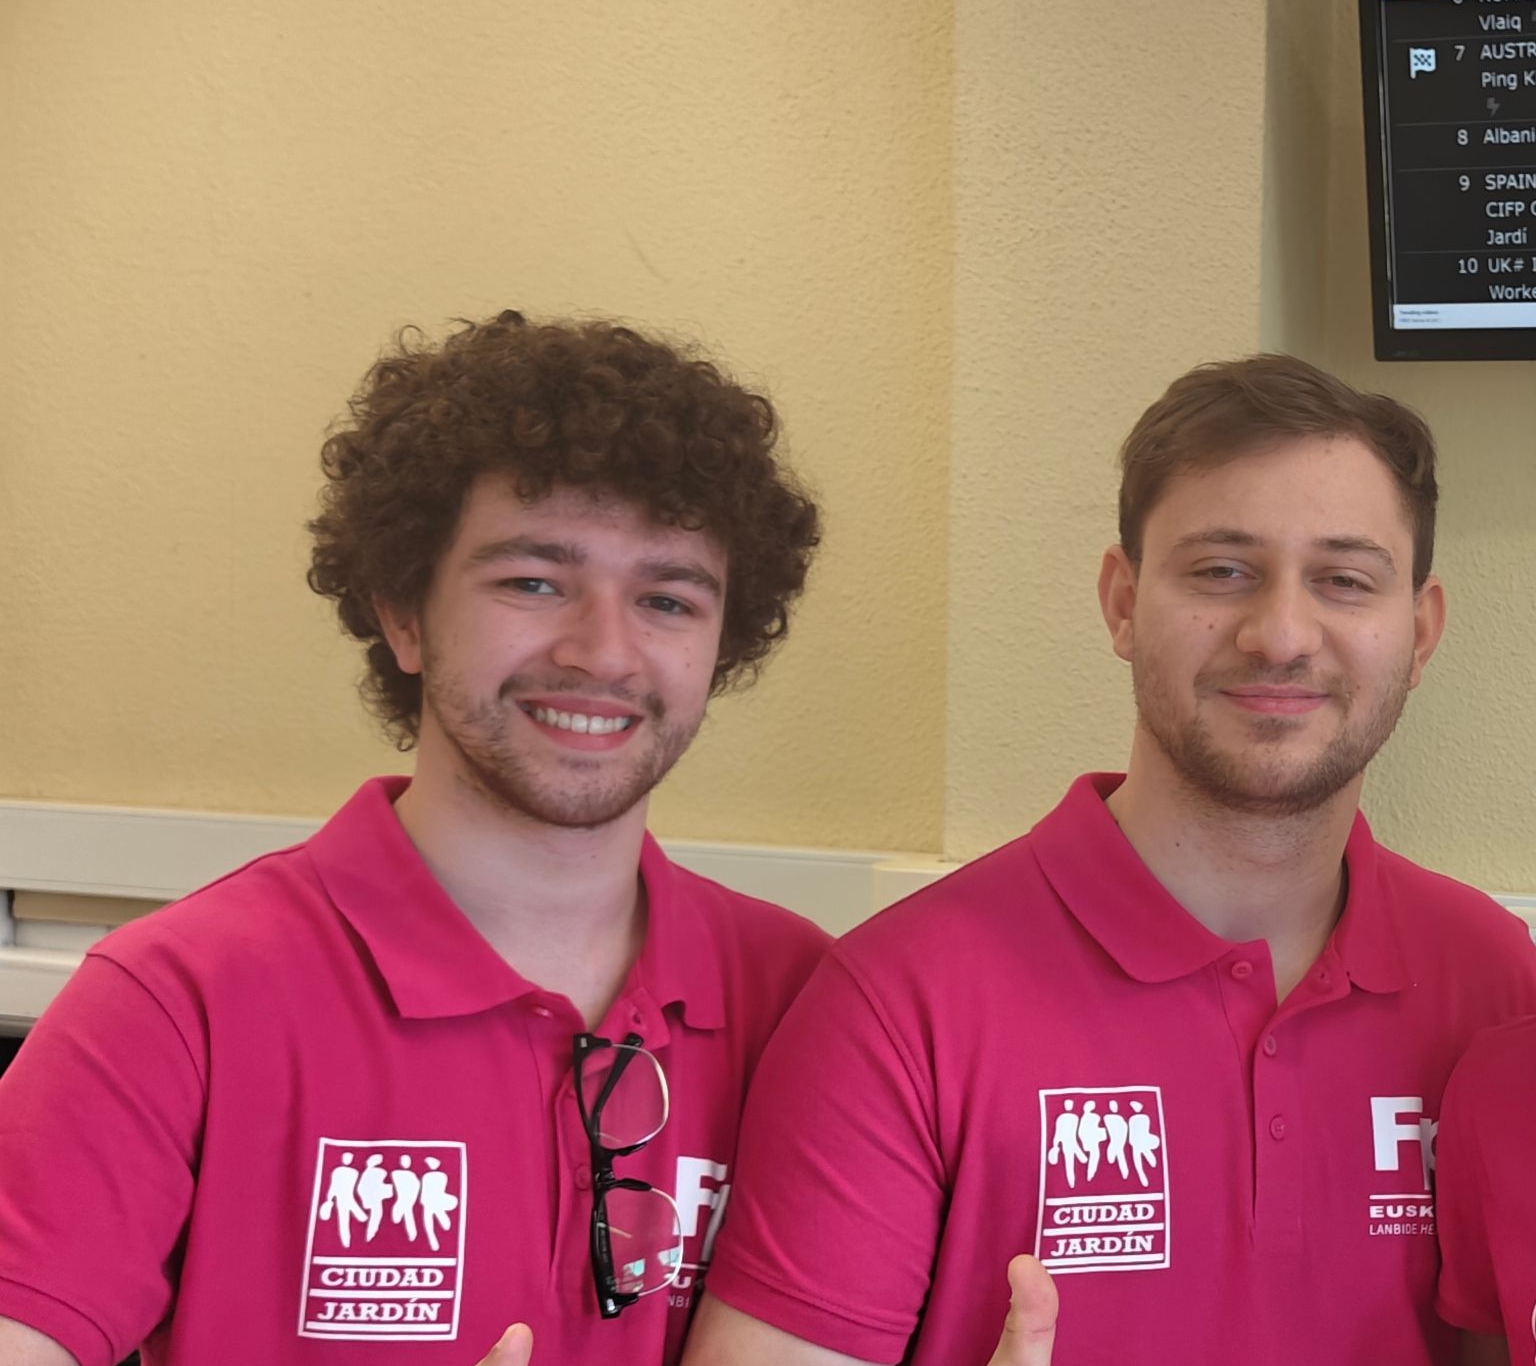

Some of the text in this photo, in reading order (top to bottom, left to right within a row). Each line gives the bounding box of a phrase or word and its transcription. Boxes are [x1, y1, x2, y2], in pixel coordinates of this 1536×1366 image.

[1454, 45, 1465, 62] 7
[1481, 71, 1518, 91] Ping
[1457, 129, 1469, 146] 8
[1458, 174, 1470, 191] 9
[1485, 201, 1525, 218] CIFP
[1457, 258, 1478, 274] 10
[1487, 257, 1524, 273] UK#
[1053, 1204, 1155, 1225] CIUDAD
[1369, 1205, 1434, 1219] EUSK
[1369, 1223, 1418, 1236] LANBIDE
[1050, 1231, 1155, 1257] JARDÍN
[321, 1267, 444, 1287] CIUDAD
[317, 1298, 442, 1322] JARDÍN
